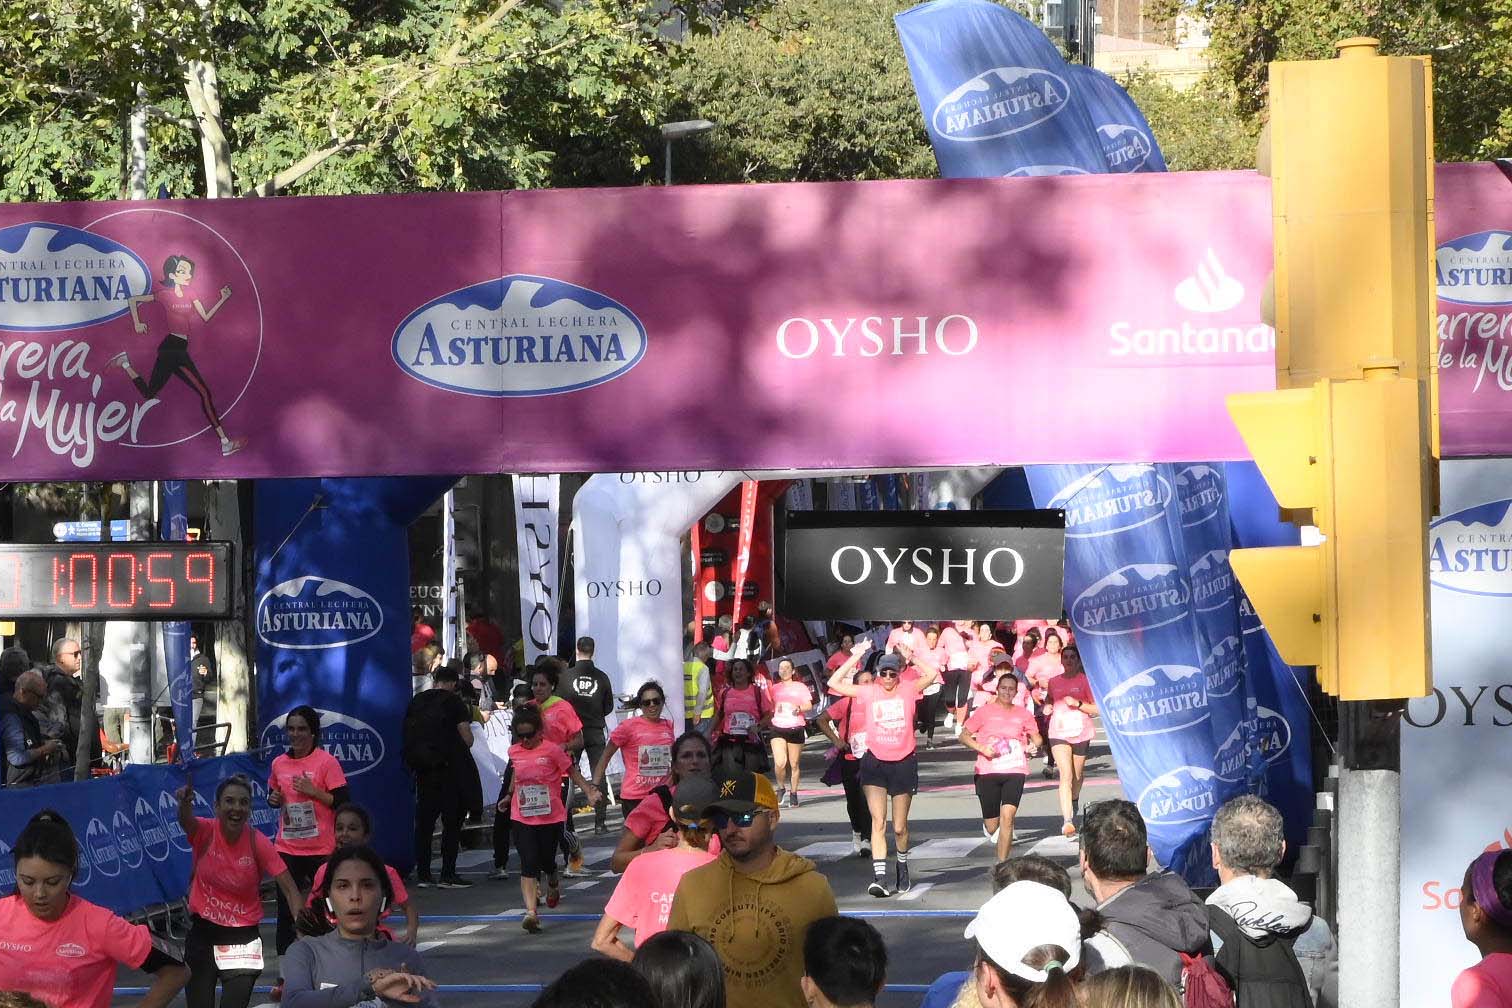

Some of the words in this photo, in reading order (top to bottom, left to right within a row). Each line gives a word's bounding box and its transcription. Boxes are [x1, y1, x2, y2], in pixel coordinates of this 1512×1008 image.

[54, 258, 126, 270] LECHERA
[451, 318, 530, 330] CENTRAL
[537, 316, 619, 329] LECHERA
[775, 314, 979, 358] OYSHO
[412, 322, 627, 367] ASTURIANA
[1109, 321, 1276, 356] Santand
[1459, 350, 1477, 370] la
[12, 374, 160, 468] Mujer
[830, 545, 1024, 587] OYSHO
[586, 579, 663, 599] OYSHO
[261, 604, 374, 633] ASTURIANA
[579, 680, 592, 690] BP
